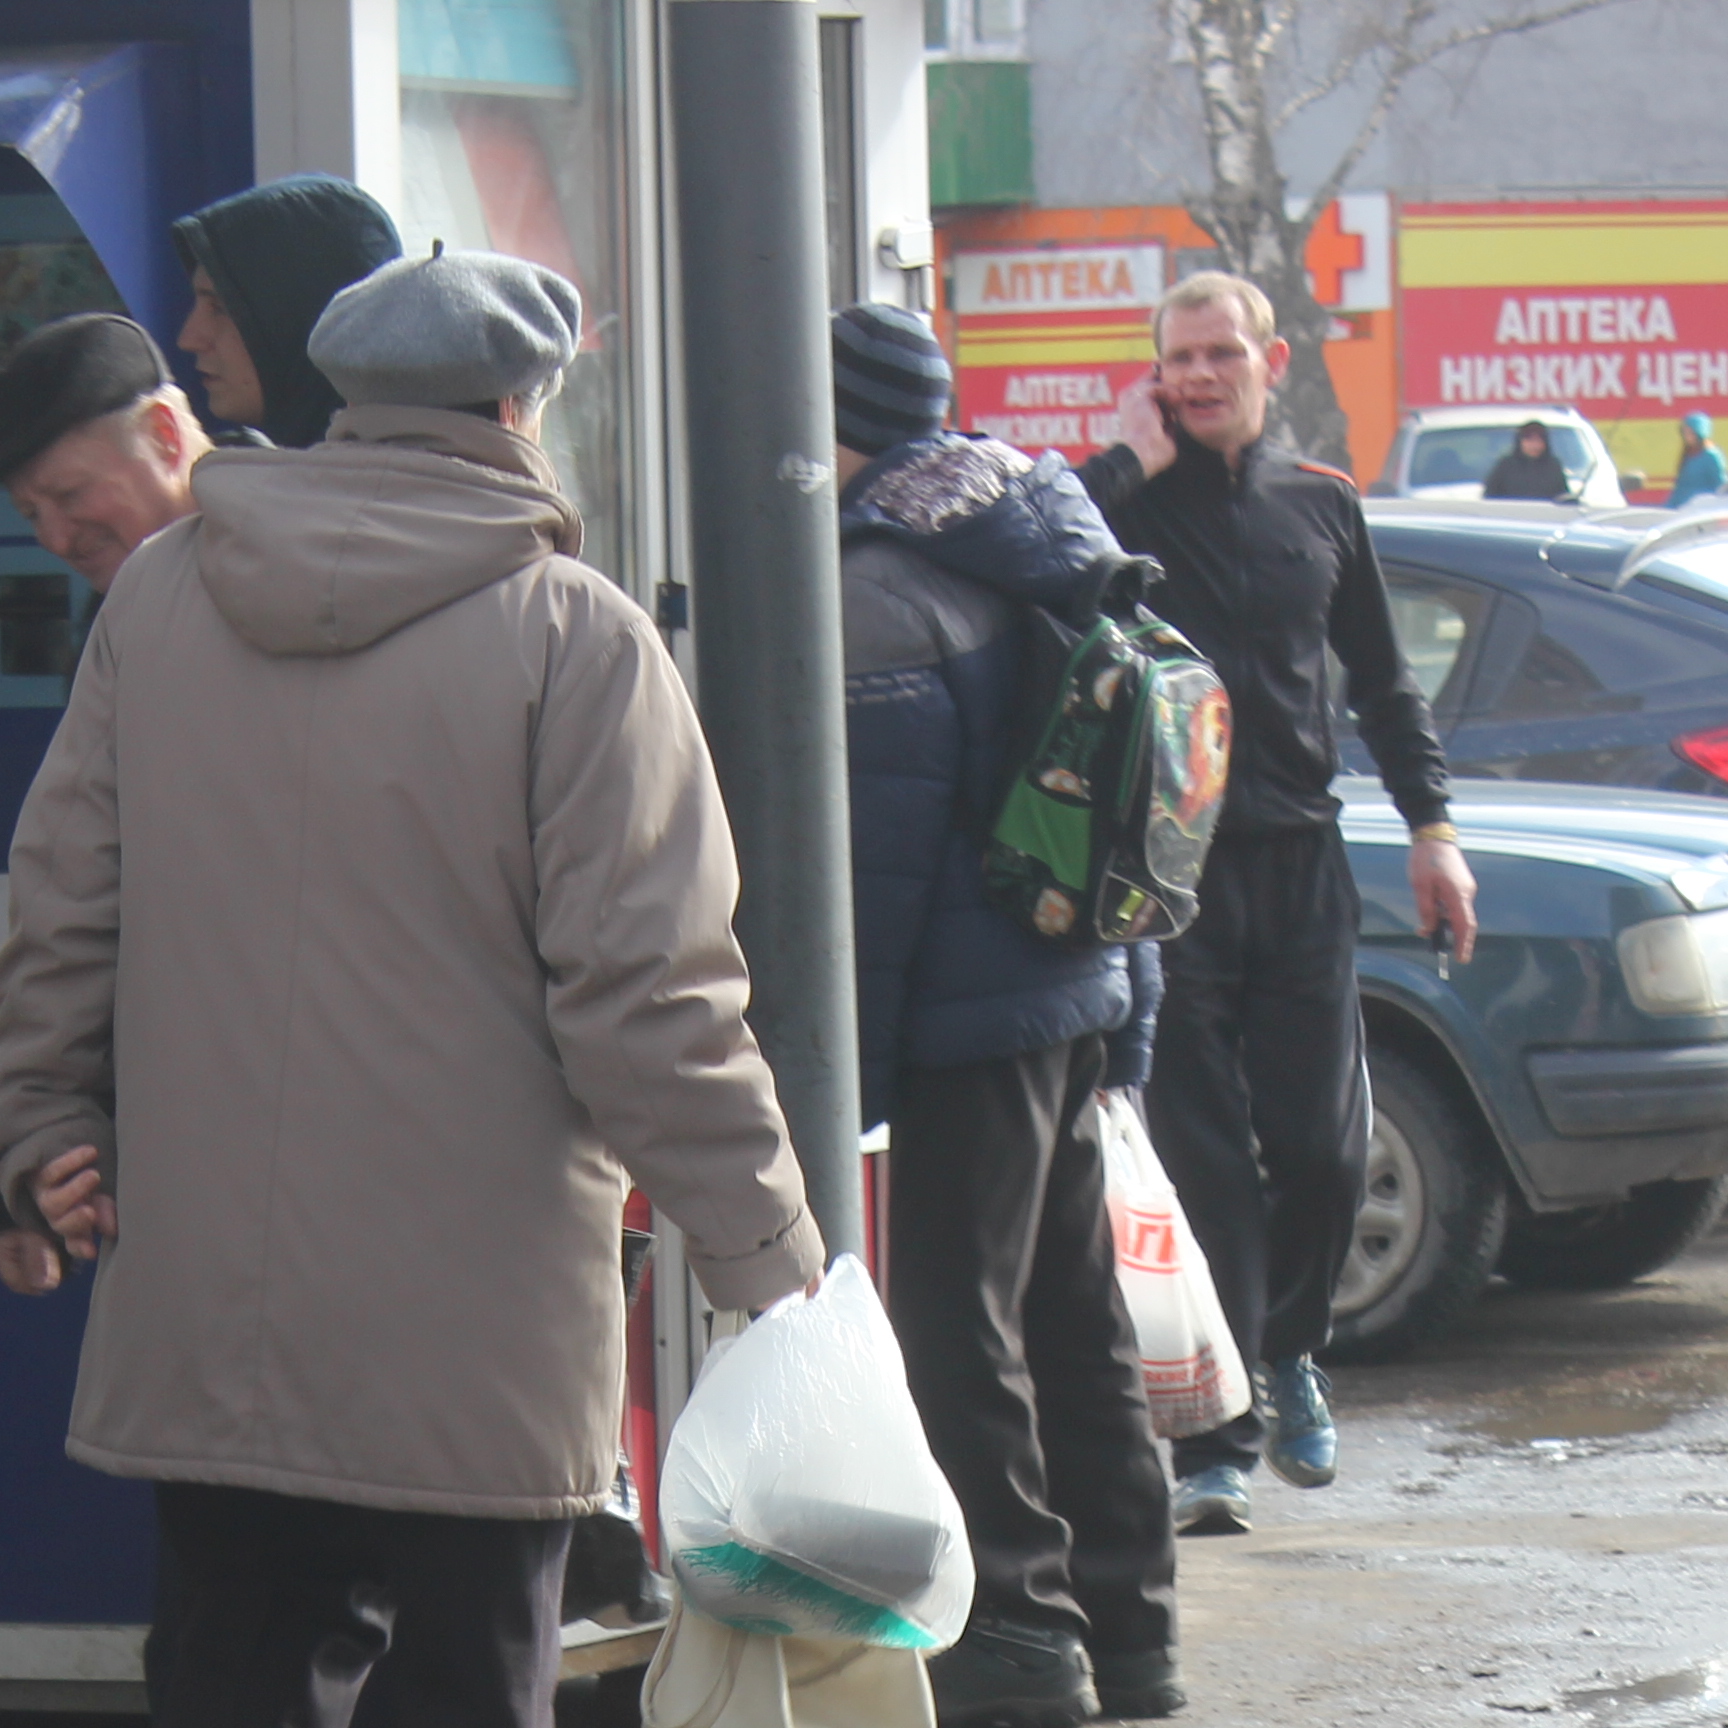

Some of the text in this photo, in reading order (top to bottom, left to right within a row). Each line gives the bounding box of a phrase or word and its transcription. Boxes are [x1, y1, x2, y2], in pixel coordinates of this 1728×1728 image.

[983, 262, 1134, 302] АПТЕКА
[1494, 297, 1677, 344] АПТЕКА
[1005, 375, 1113, 407] АПТЕКА
[1440, 354, 1625, 402] НИЗКИХ
